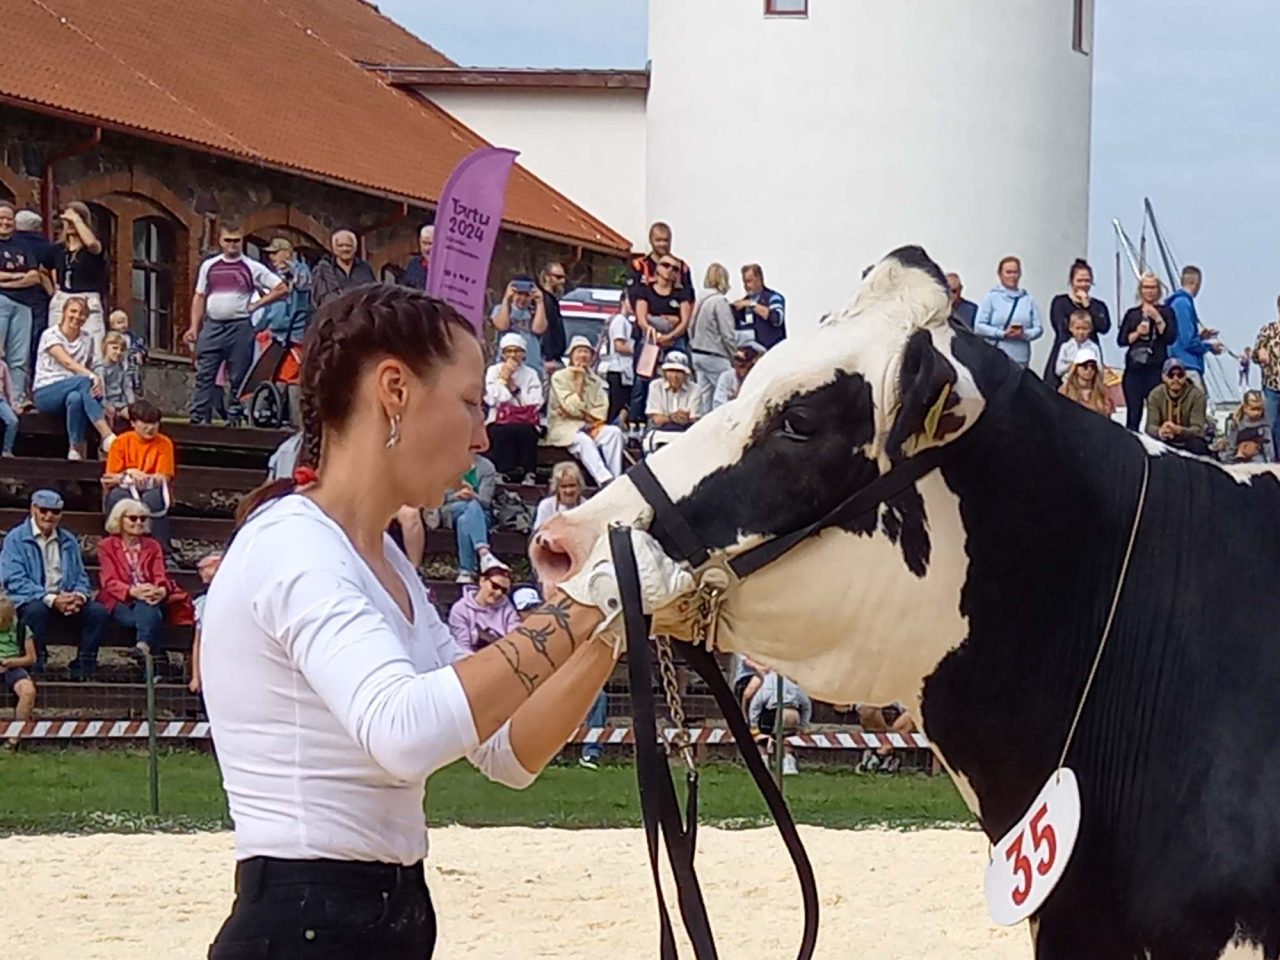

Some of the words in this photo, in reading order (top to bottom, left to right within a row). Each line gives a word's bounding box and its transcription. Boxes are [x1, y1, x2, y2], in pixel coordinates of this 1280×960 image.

[451, 197, 491, 226] Tartu
[449, 216, 484, 242] 2024
[1005, 802, 1057, 906] 35
